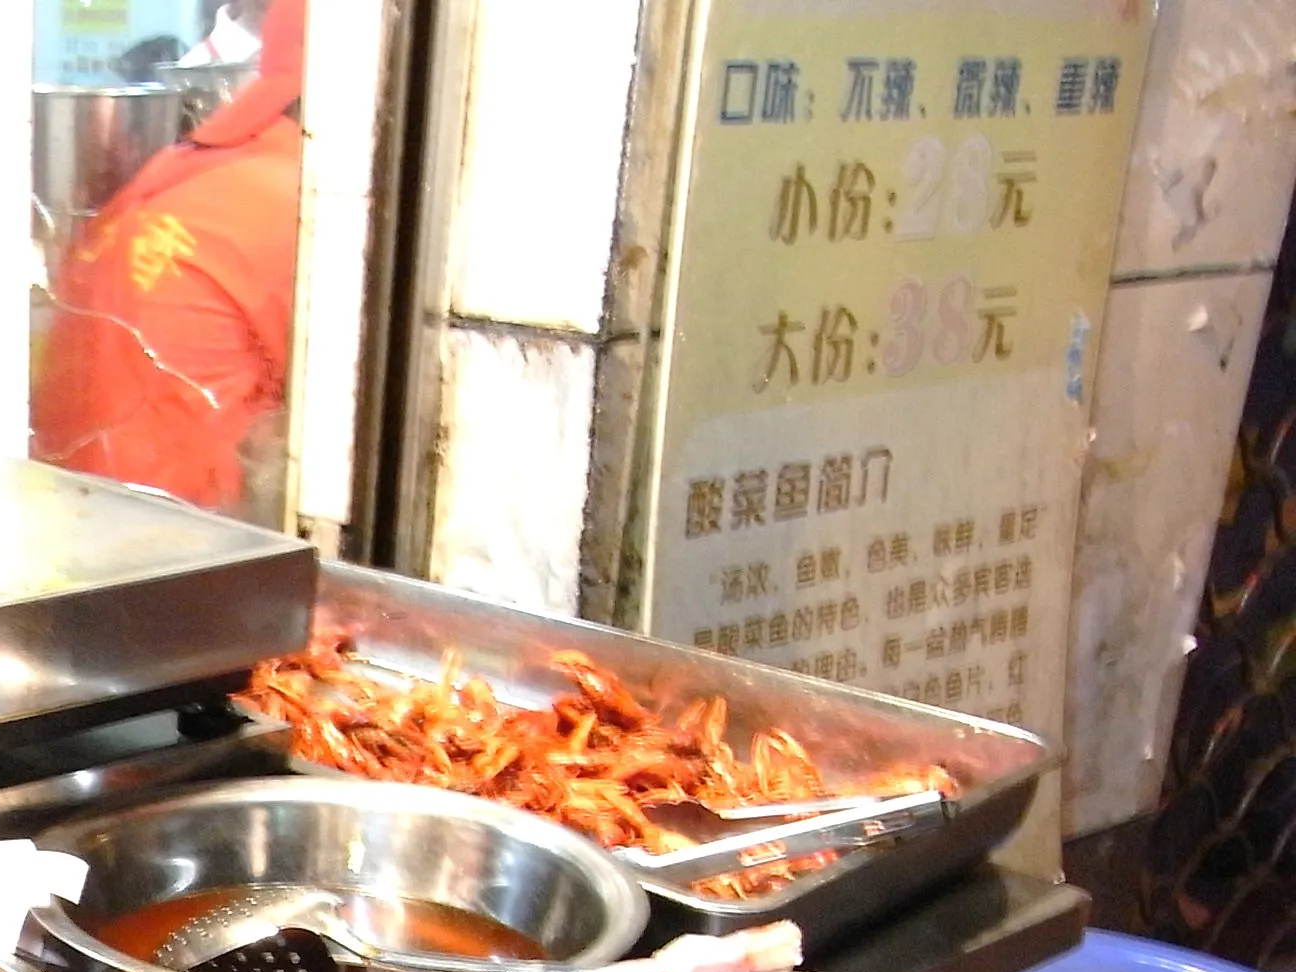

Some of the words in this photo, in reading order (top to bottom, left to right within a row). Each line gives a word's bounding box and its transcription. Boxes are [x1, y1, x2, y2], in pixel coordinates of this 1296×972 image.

[685, 444, 894, 539] 酸菜鱼简介
